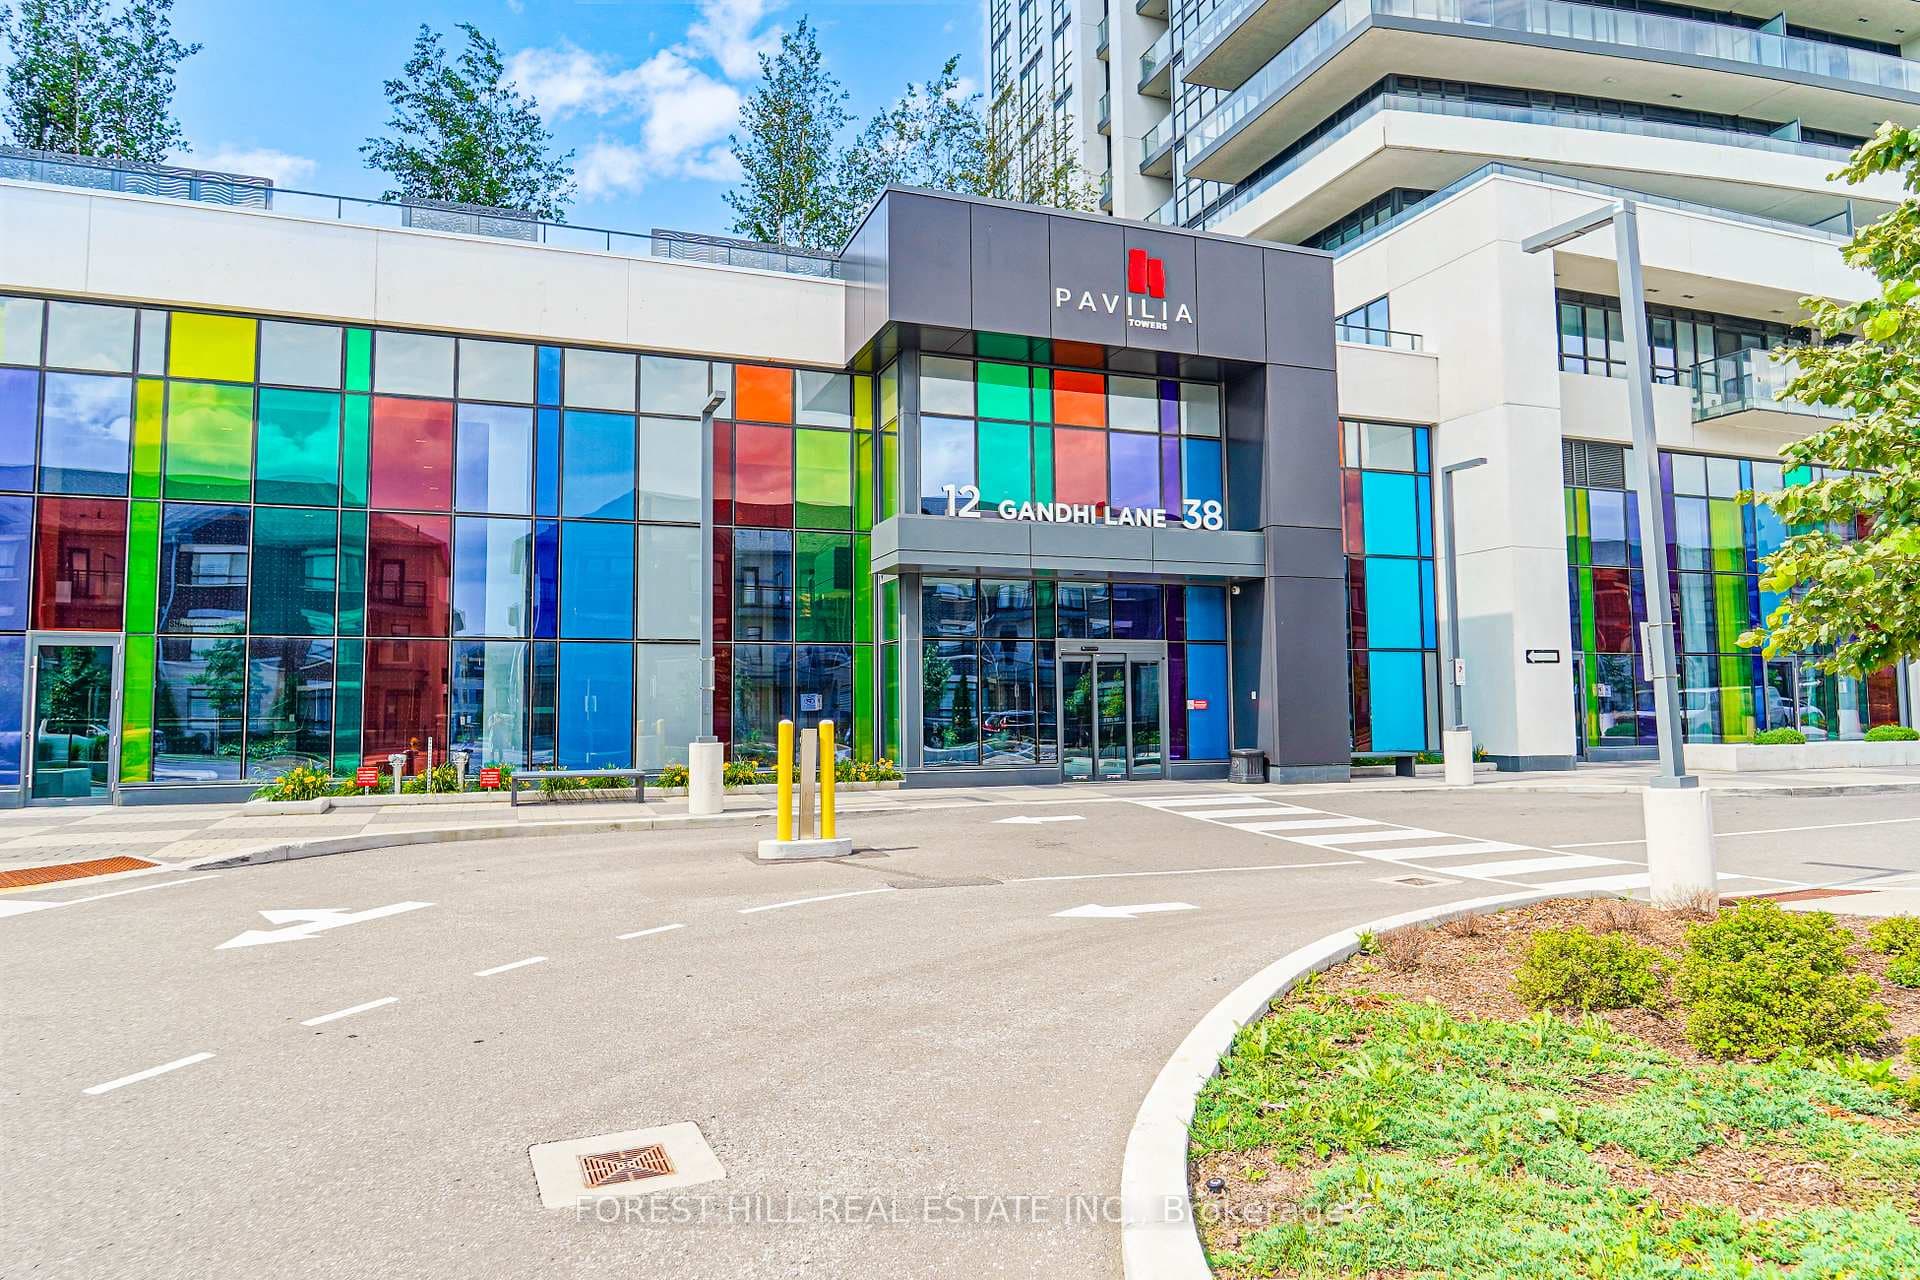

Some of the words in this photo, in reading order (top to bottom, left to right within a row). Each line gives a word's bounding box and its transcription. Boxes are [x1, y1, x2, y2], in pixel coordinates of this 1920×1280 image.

[1055, 287, 1193, 324] PAVILIA
[1127, 318, 1168, 330] TOWERS
[942, 484, 981, 518] 12
[999, 499, 1096, 525] GANDHI
[1104, 506, 1167, 528] LANE
[1182, 498, 1224, 530] 38
